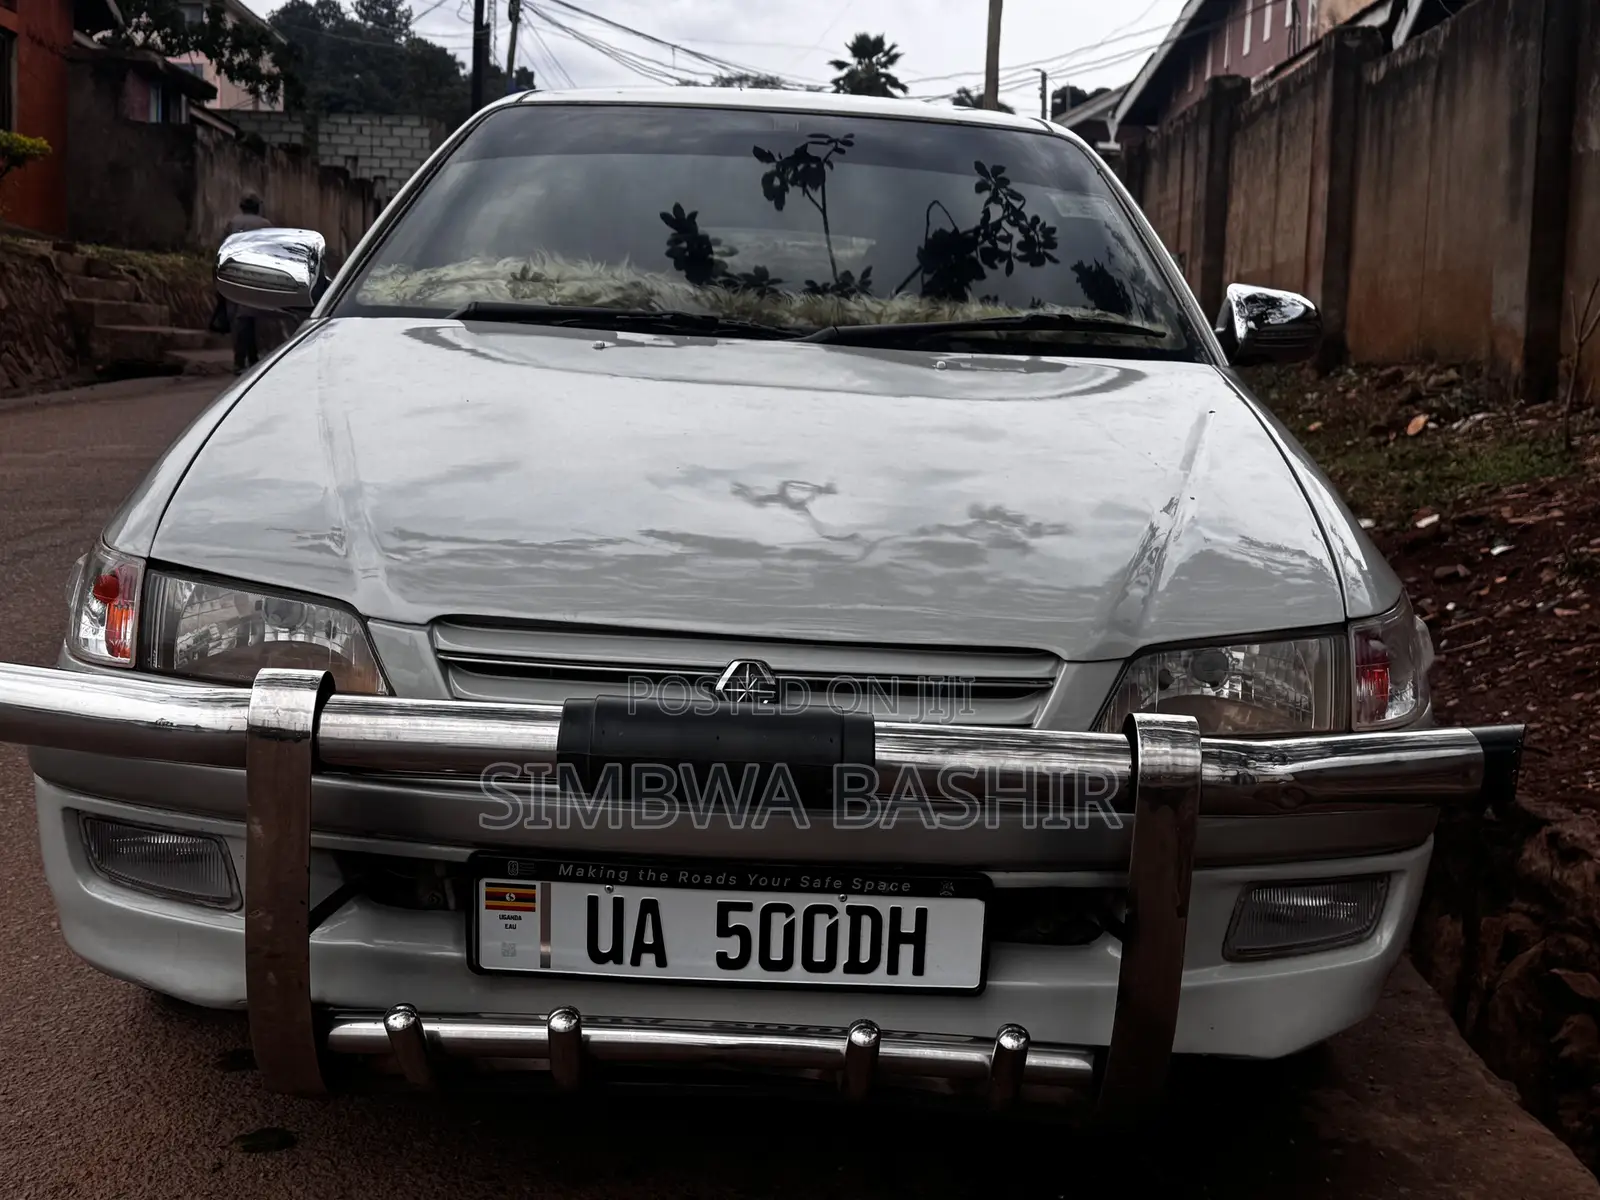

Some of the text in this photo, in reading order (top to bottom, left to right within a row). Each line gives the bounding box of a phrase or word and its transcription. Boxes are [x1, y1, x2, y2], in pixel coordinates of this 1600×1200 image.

[558, 863, 912, 894] Making the Roads Your Safe Space
[587, 894, 928, 977] UA 500DH
